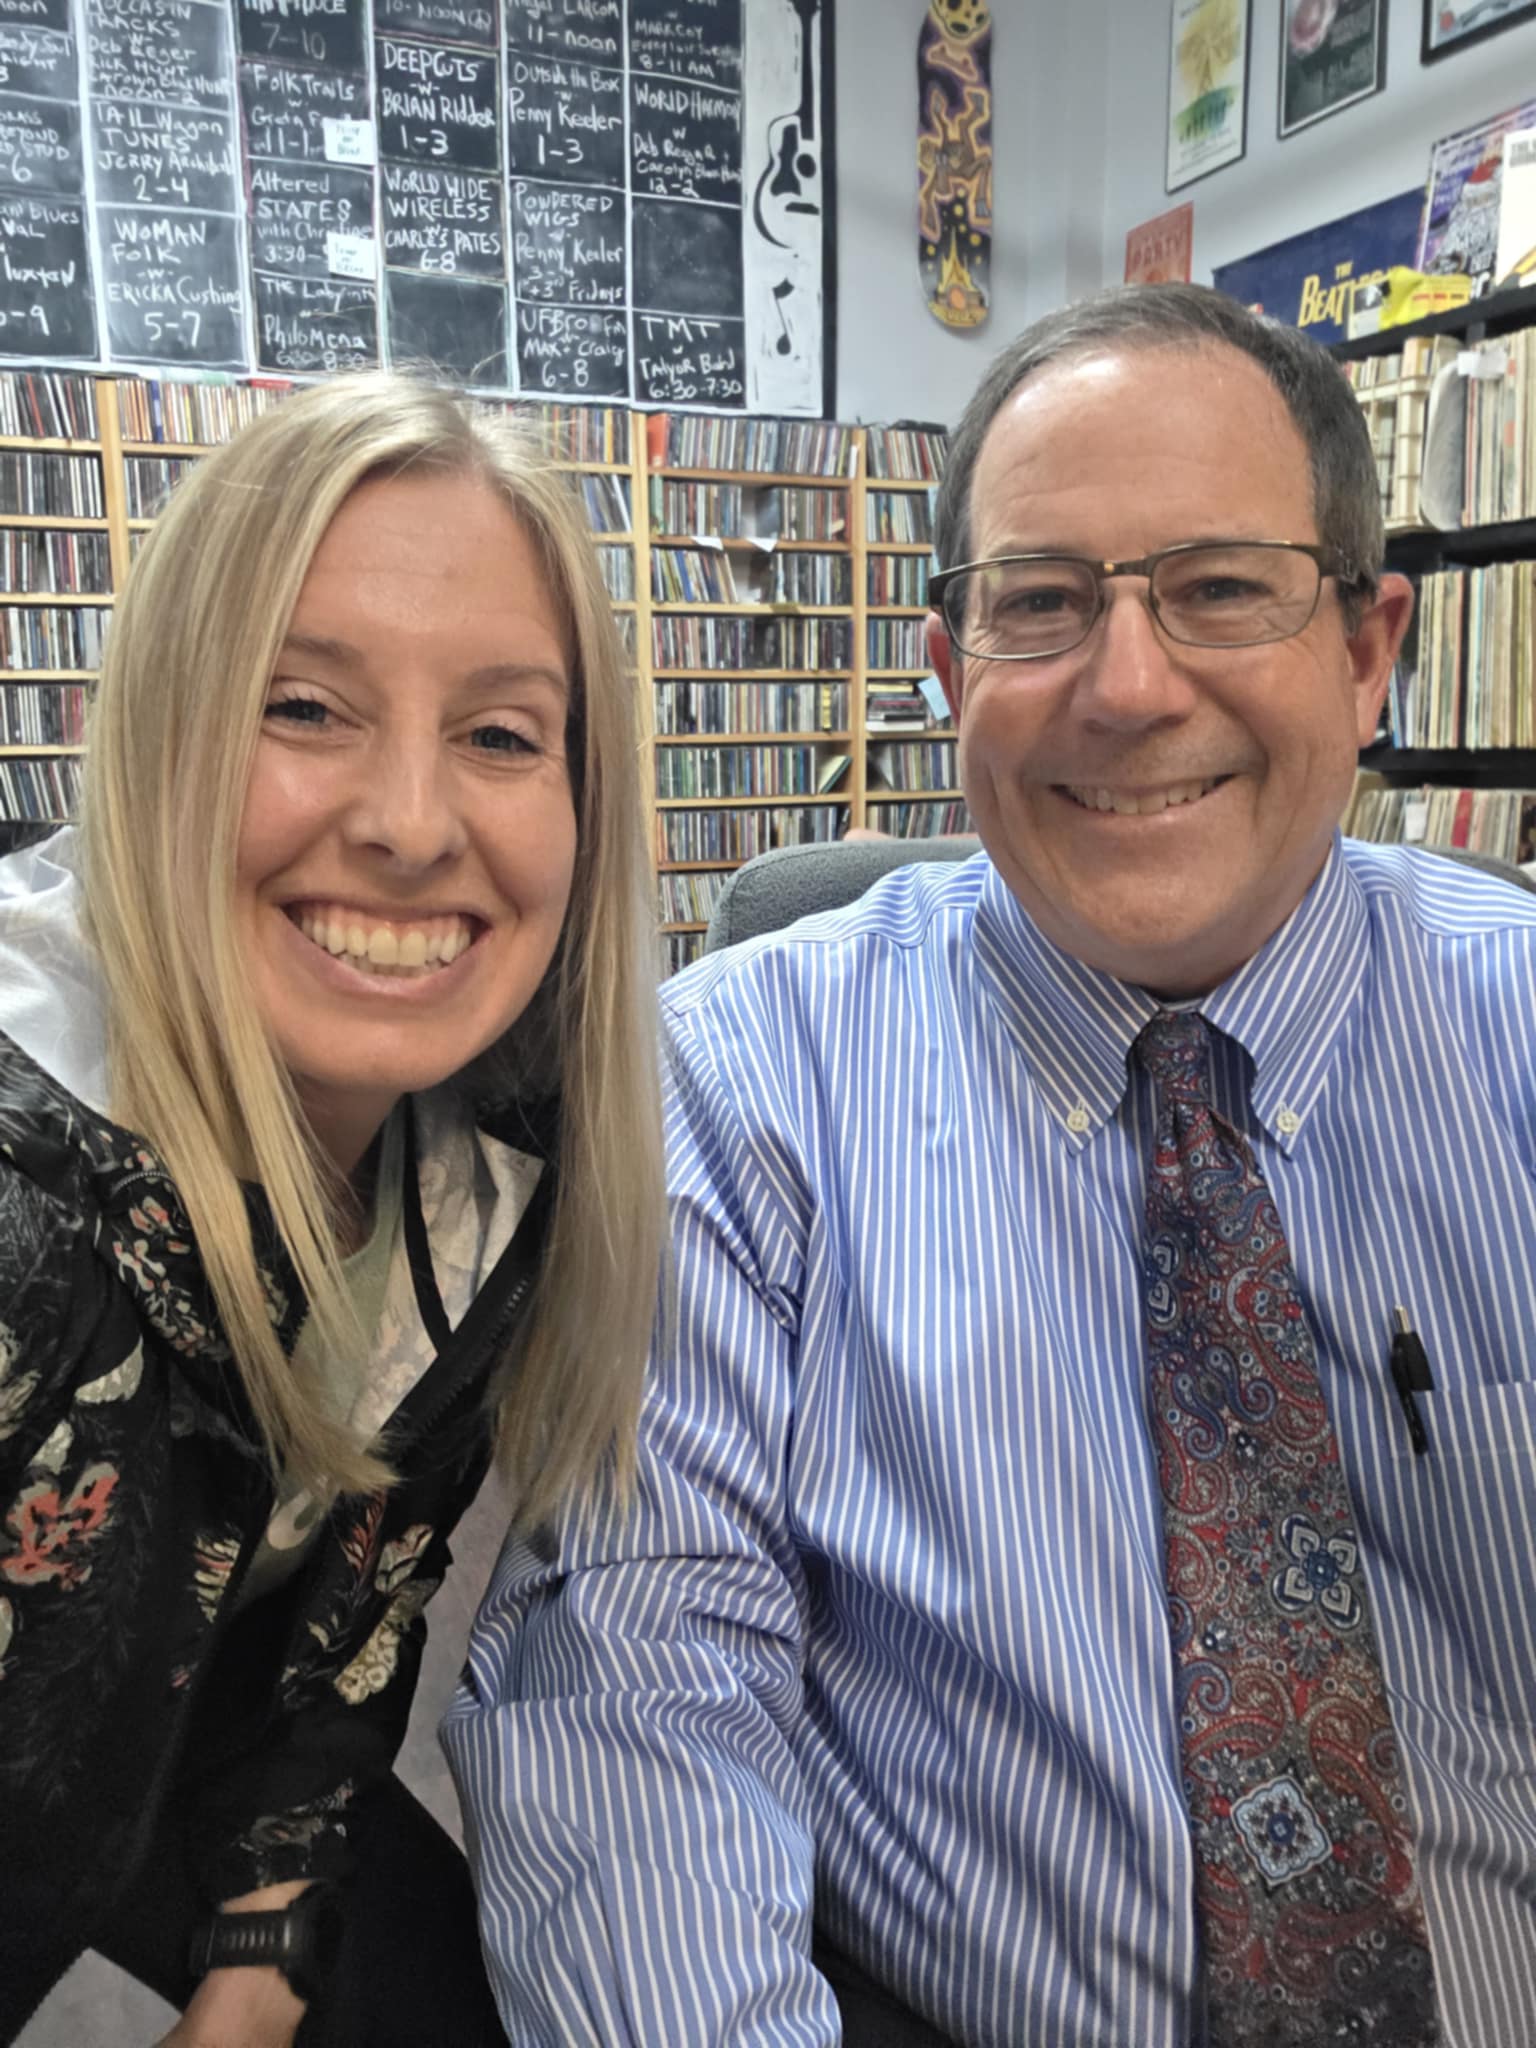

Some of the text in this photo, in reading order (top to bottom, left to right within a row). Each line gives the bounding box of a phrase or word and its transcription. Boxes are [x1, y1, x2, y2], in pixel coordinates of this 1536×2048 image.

[261, 21, 327, 61] 7-10
[381, 87, 437, 122] BRIAN
[508, 86, 552, 134] Penny
[102, 128, 191, 154] TUNES
[400, 124, 449, 156] 1-3
[537, 133, 585, 166] 1-3
[133, 174, 190, 203] 2-4
[251, 167, 331, 196] Altered
[443, 174, 493, 202] WIDE
[257, 197, 353, 223] STATES
[387, 196, 490, 223] WIRELESS
[523, 210, 580, 227] WIGS
[452, 228, 501, 256] PATES
[144, 309, 201, 349] 5-7
[541, 358, 591, 389] 6-8
